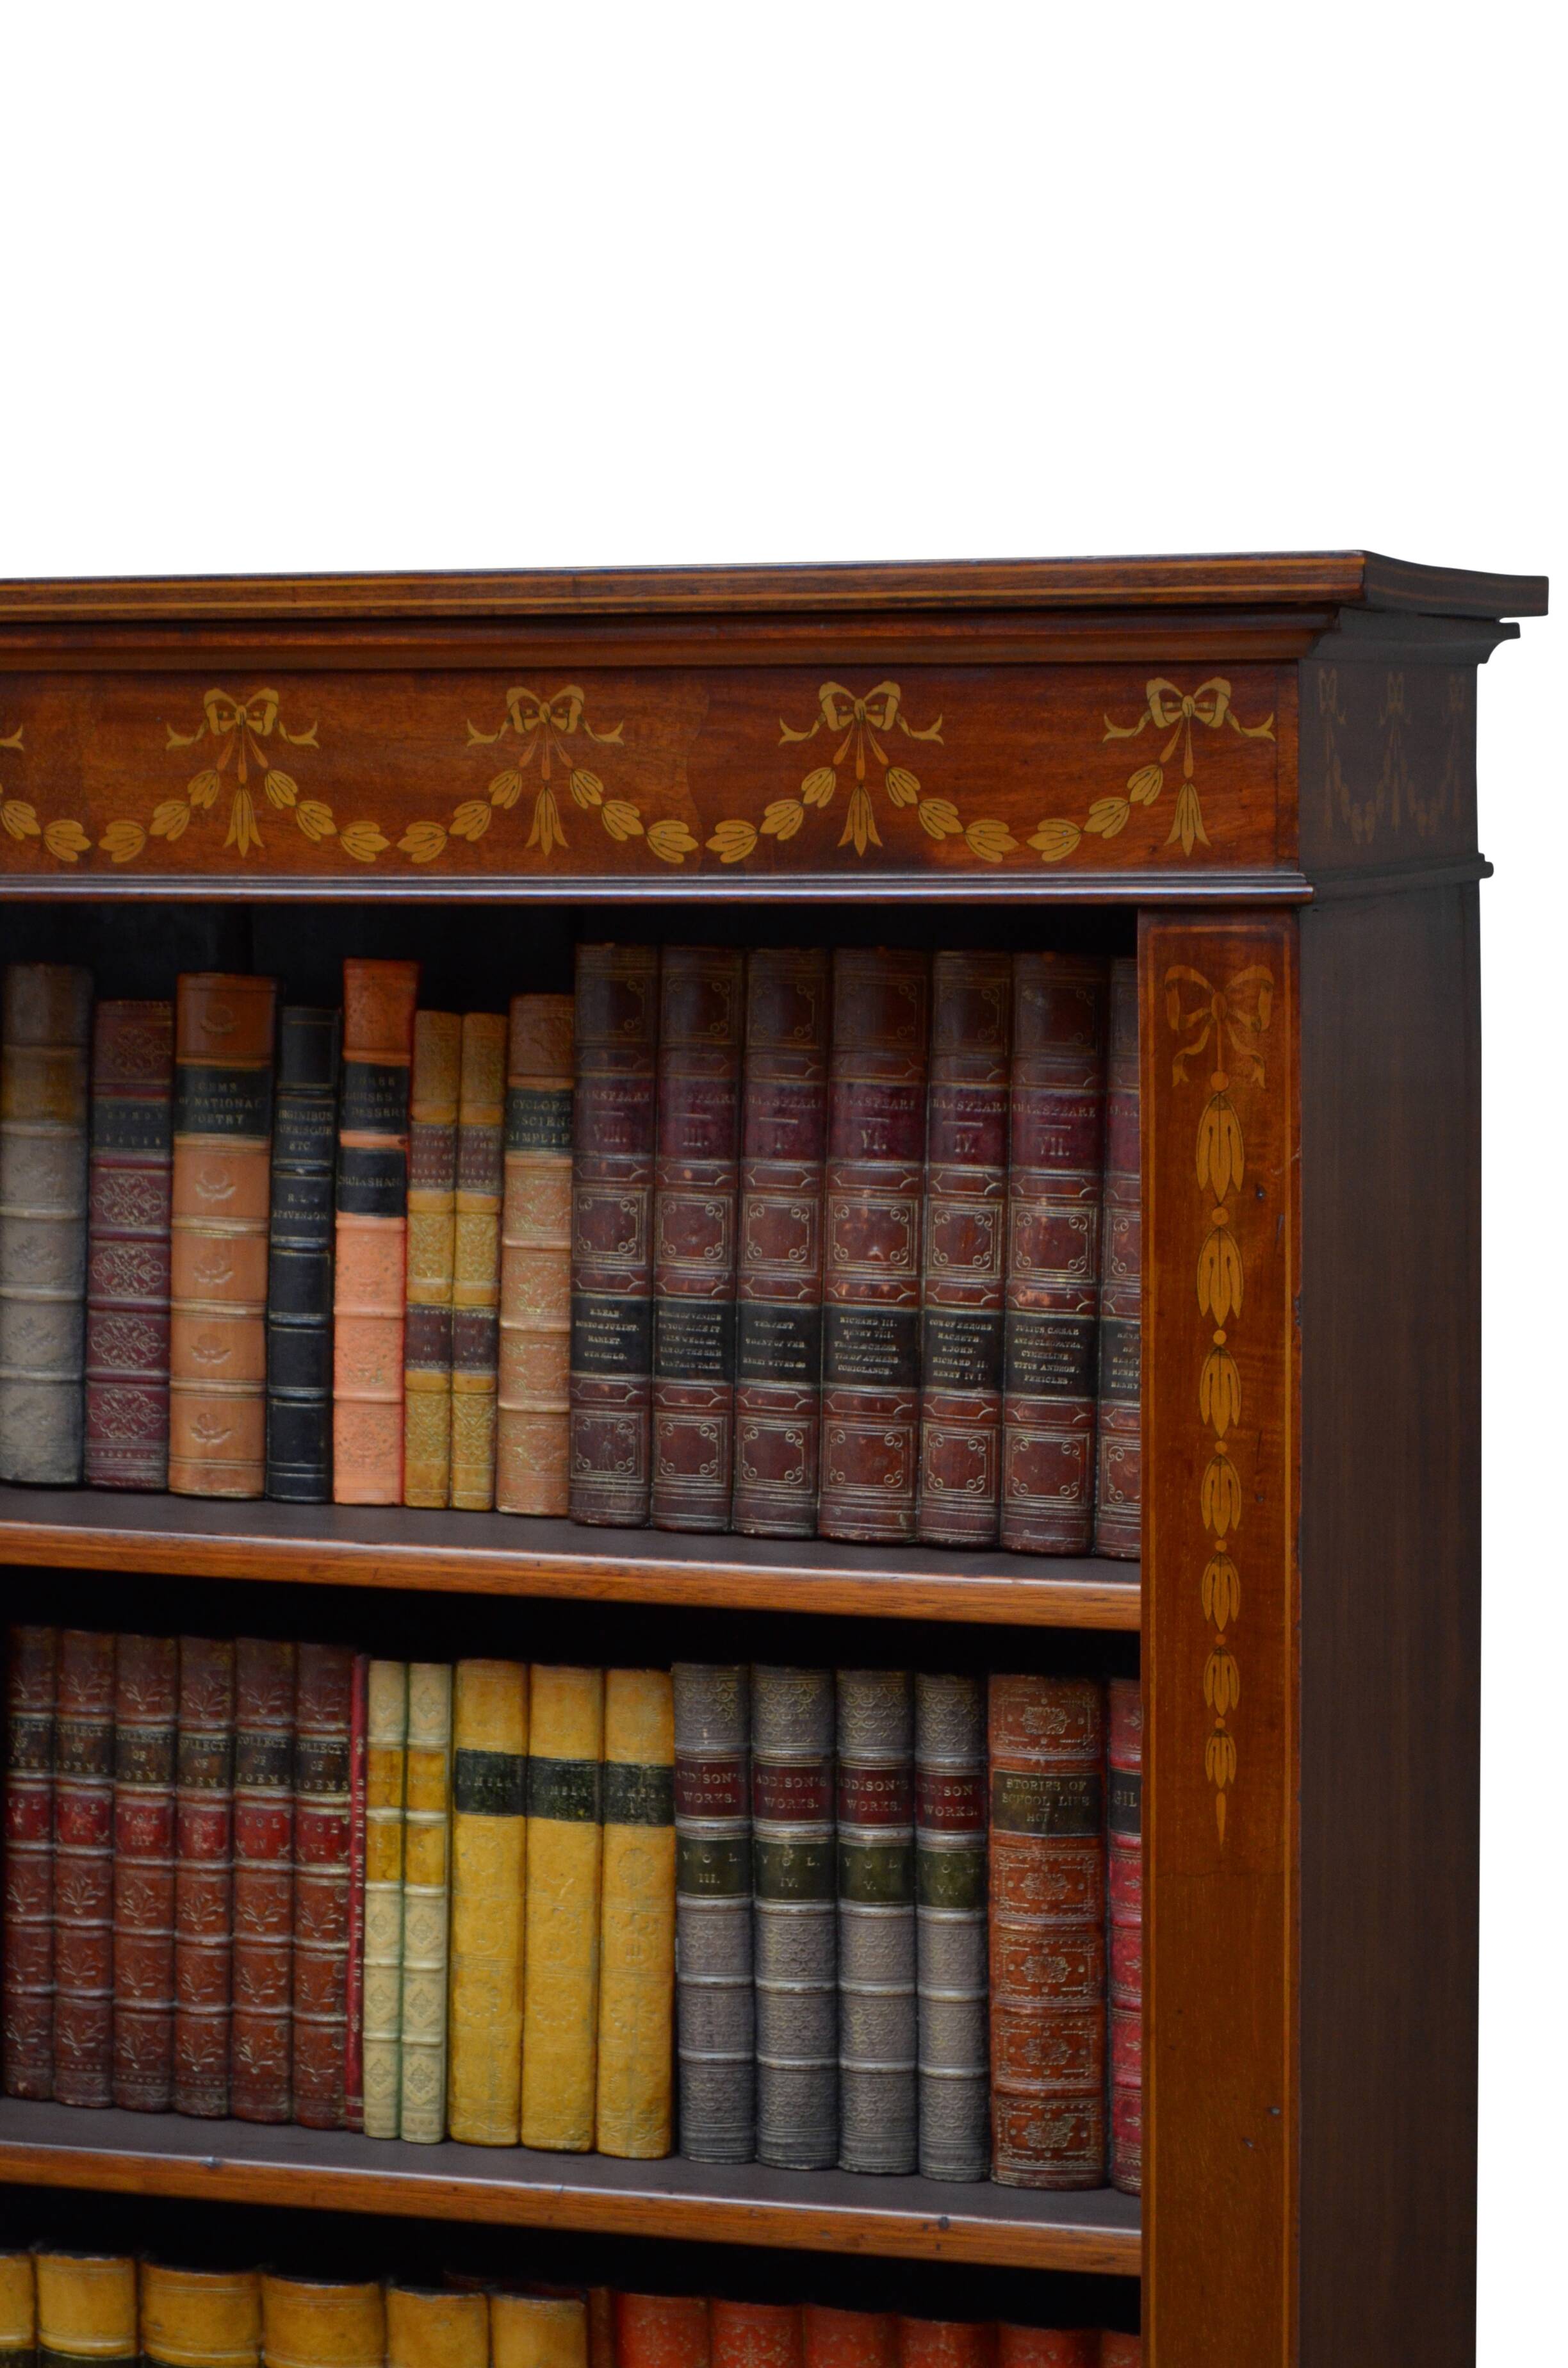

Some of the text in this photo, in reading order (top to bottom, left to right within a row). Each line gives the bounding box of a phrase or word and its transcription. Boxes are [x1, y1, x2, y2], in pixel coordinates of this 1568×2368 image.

[756, 1776, 827, 1788] ADDISON'S
[1006, 1778, 1088, 1791] STORIES OF
[683, 1791, 736, 1804] WORKS.
[764, 1797, 819, 1809] WORKS.
[847, 1799, 902, 1812] WORKS.
[923, 1804, 978, 1817] WORKS.
[699, 1873, 721, 1884] III.
[780, 1877, 799, 1888] IV.
[863, 1880, 876, 1891] V.
[937, 1884, 959, 1896] VI.
